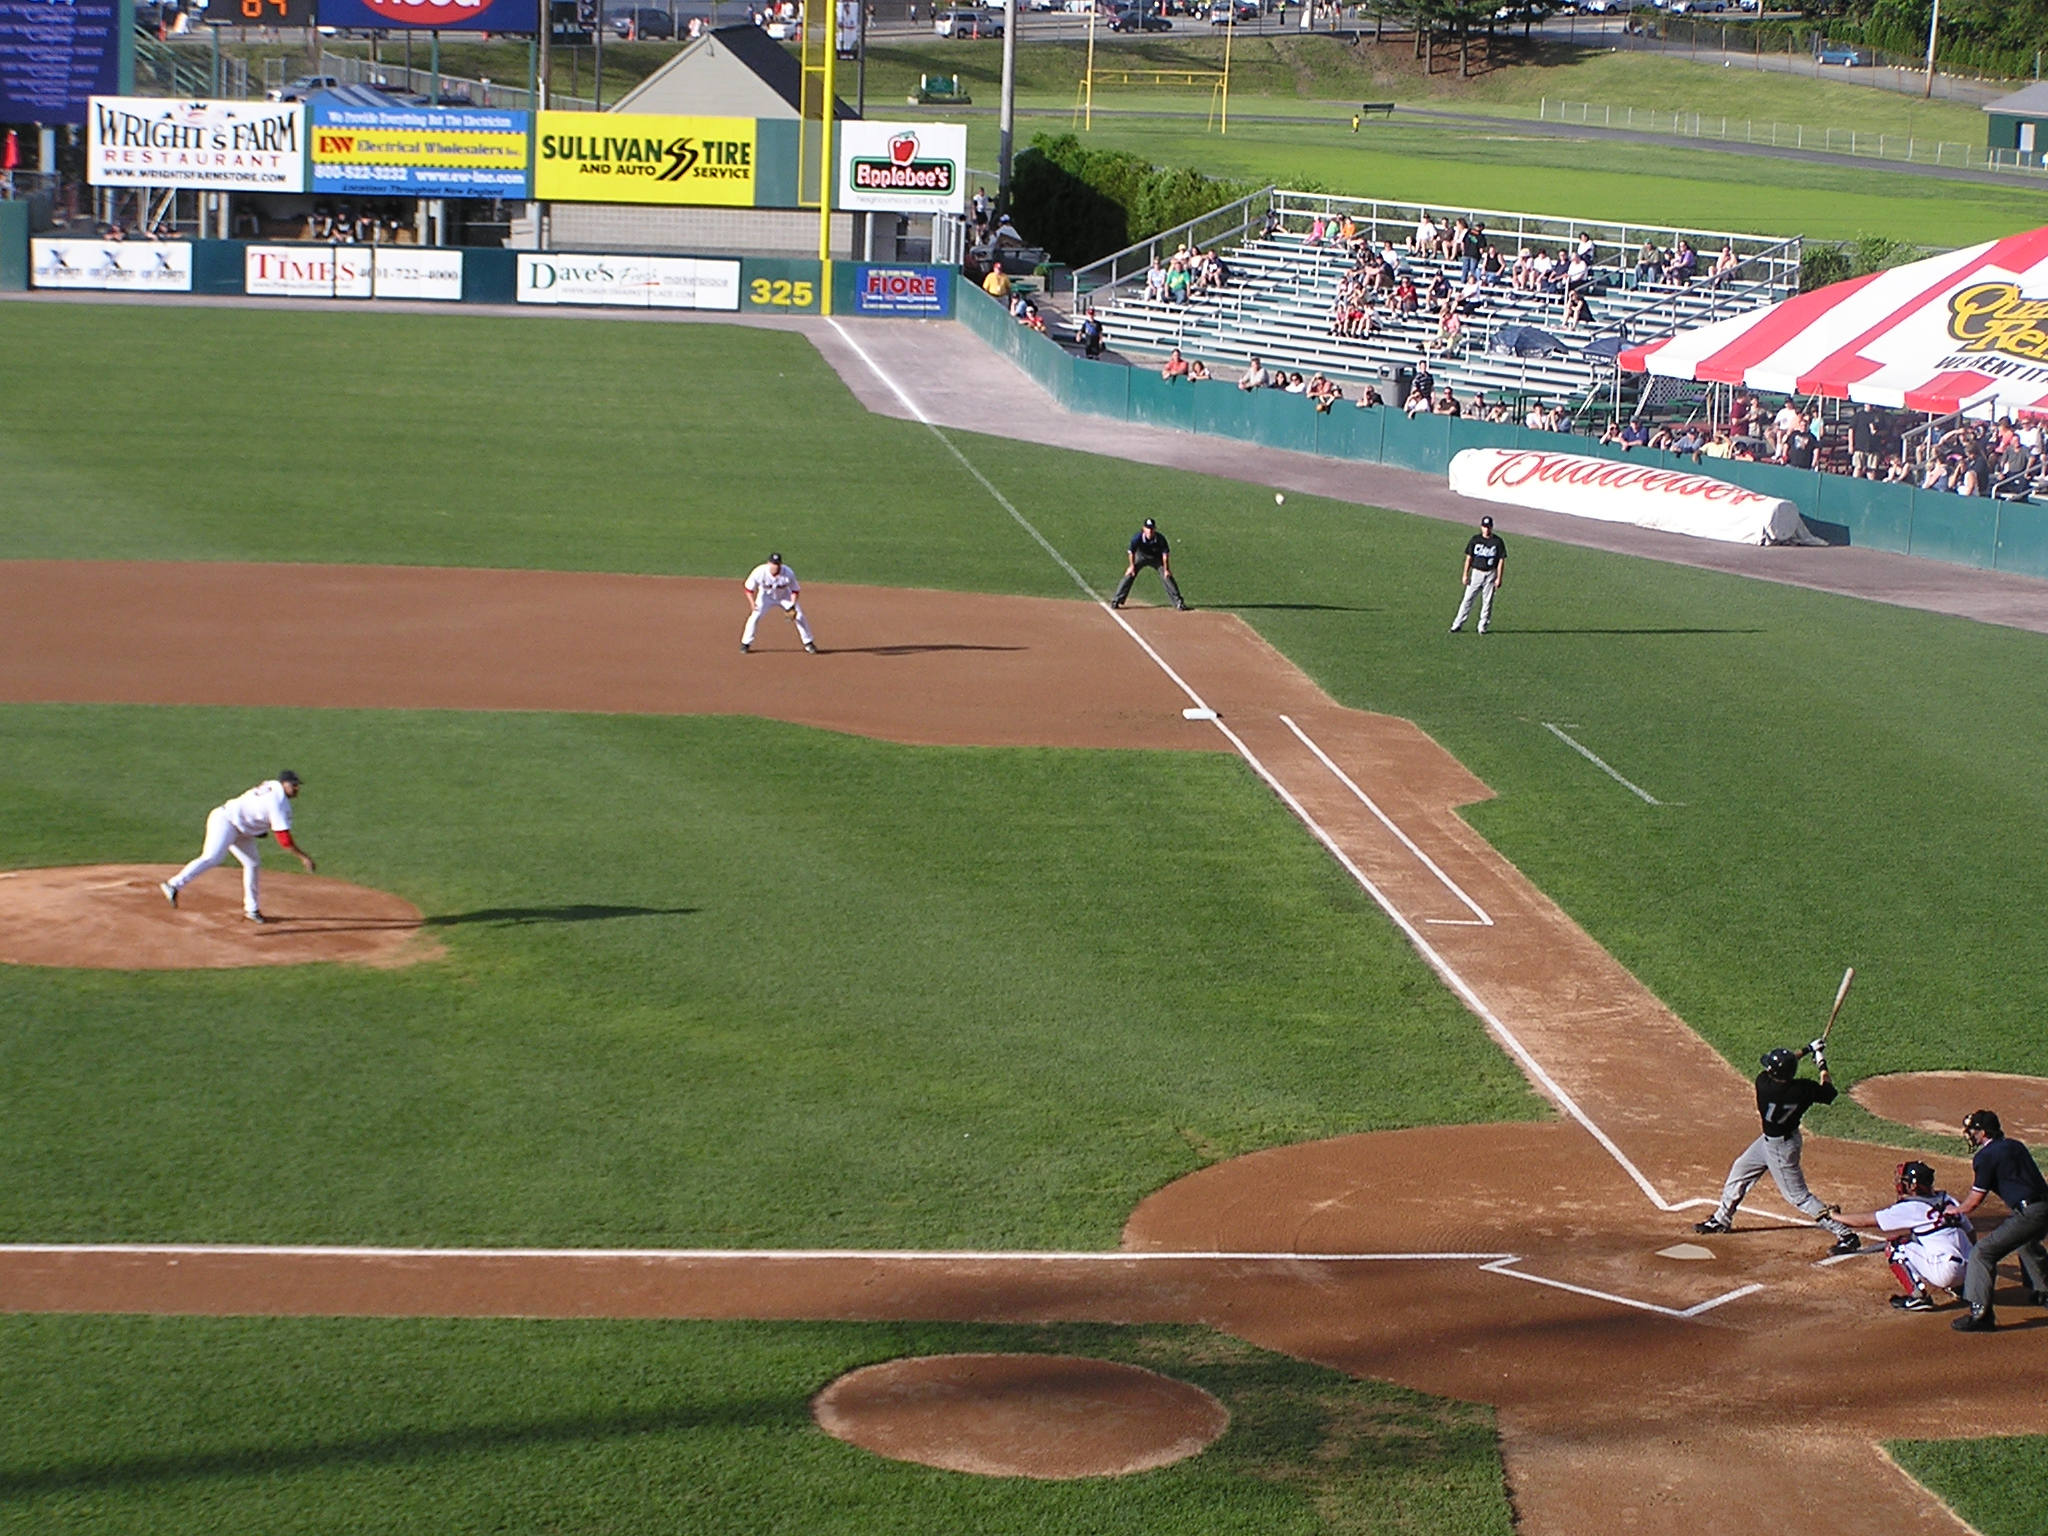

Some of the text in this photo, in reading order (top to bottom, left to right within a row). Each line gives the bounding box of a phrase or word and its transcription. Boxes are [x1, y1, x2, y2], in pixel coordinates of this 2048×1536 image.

[232, 111, 300, 153] FARM
[320, 135, 354, 154] EW
[357, 139, 420, 153] Electrical
[542, 134, 750, 166] SULLIVAN TIRE
[105, 150, 281, 168] RESTAURANT
[579, 163, 750, 179] AND AUTO SERVICE
[857, 164, 949, 189] Applebee's
[530, 262, 614, 290] Dave's
[867, 276, 937, 295] FIORE
[751, 279, 813, 306] 325
[1765, 1102, 1799, 1124] 17
